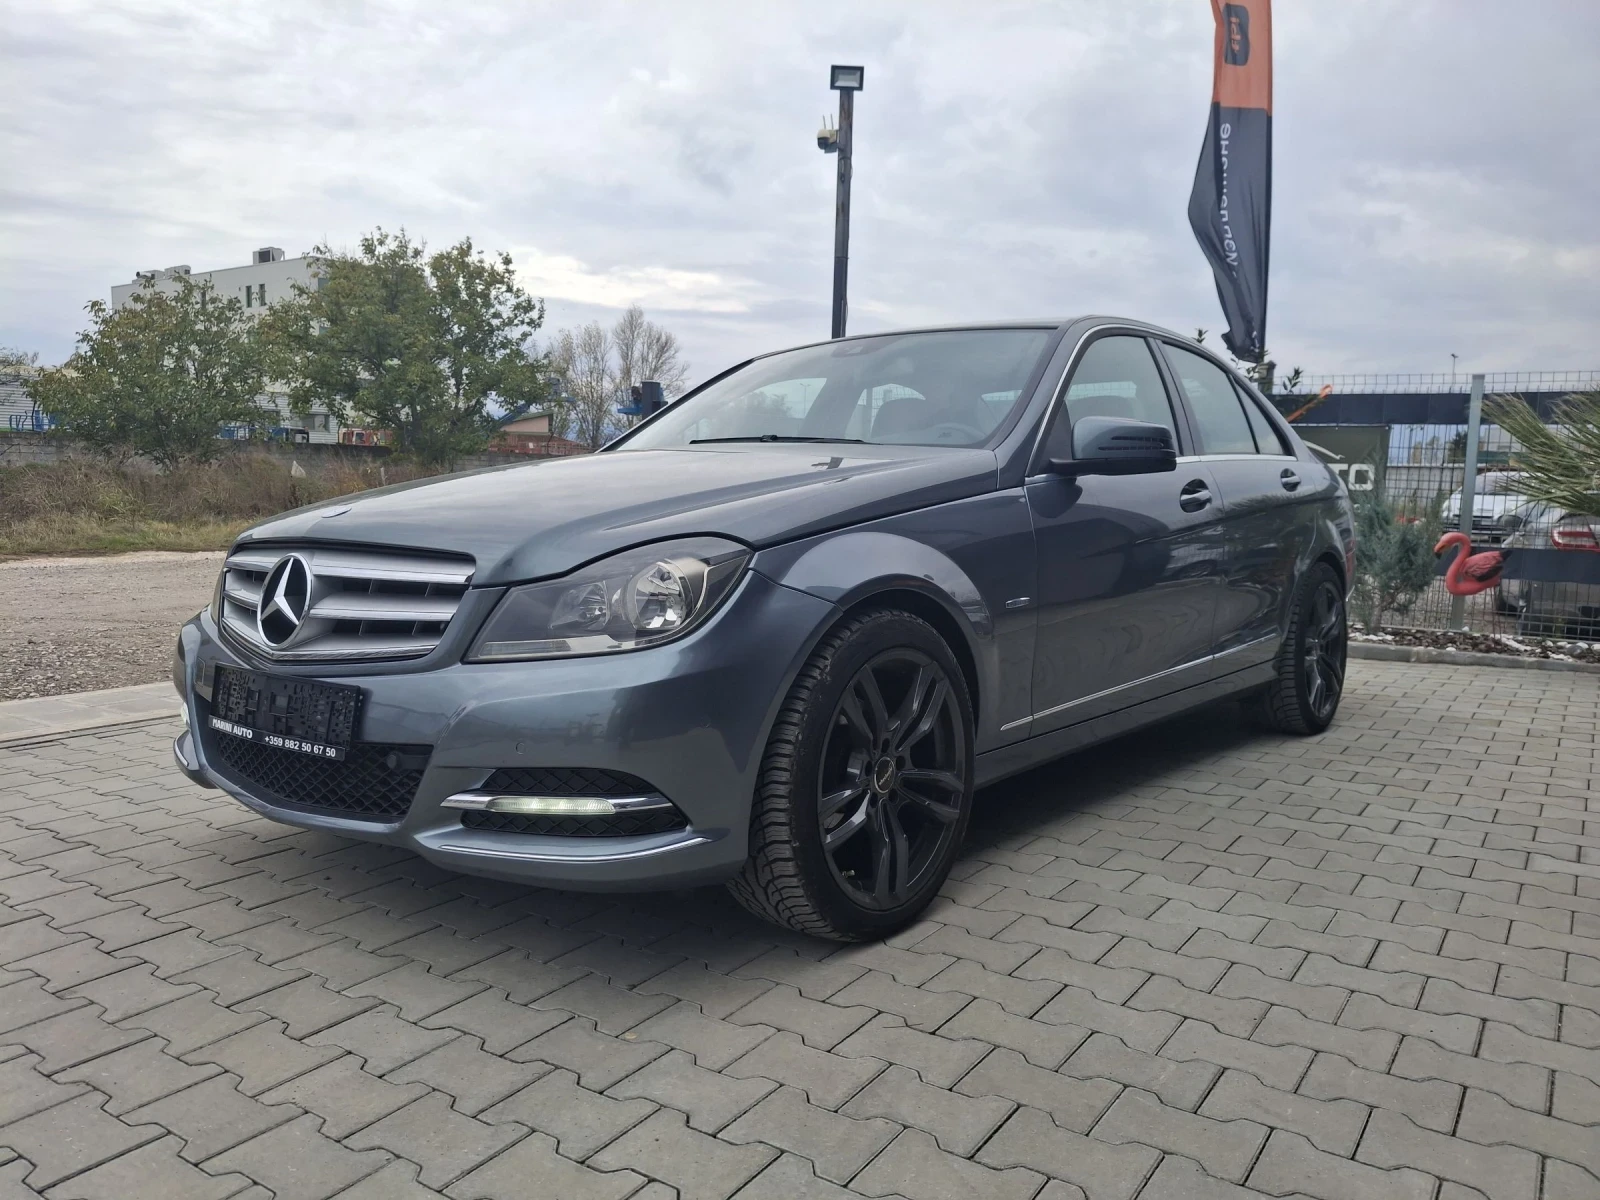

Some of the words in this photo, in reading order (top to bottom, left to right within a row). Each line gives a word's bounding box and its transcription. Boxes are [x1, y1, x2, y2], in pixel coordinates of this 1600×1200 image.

[212, 718, 233, 733] MARINI
[233, 725, 253, 739] AUTO
[265, 735, 283, 747] +359
[284, 738, 300, 750] 882
[301, 742, 312, 753] 50
[313, 744, 324, 755] 67
[325, 747, 336, 758] 50
